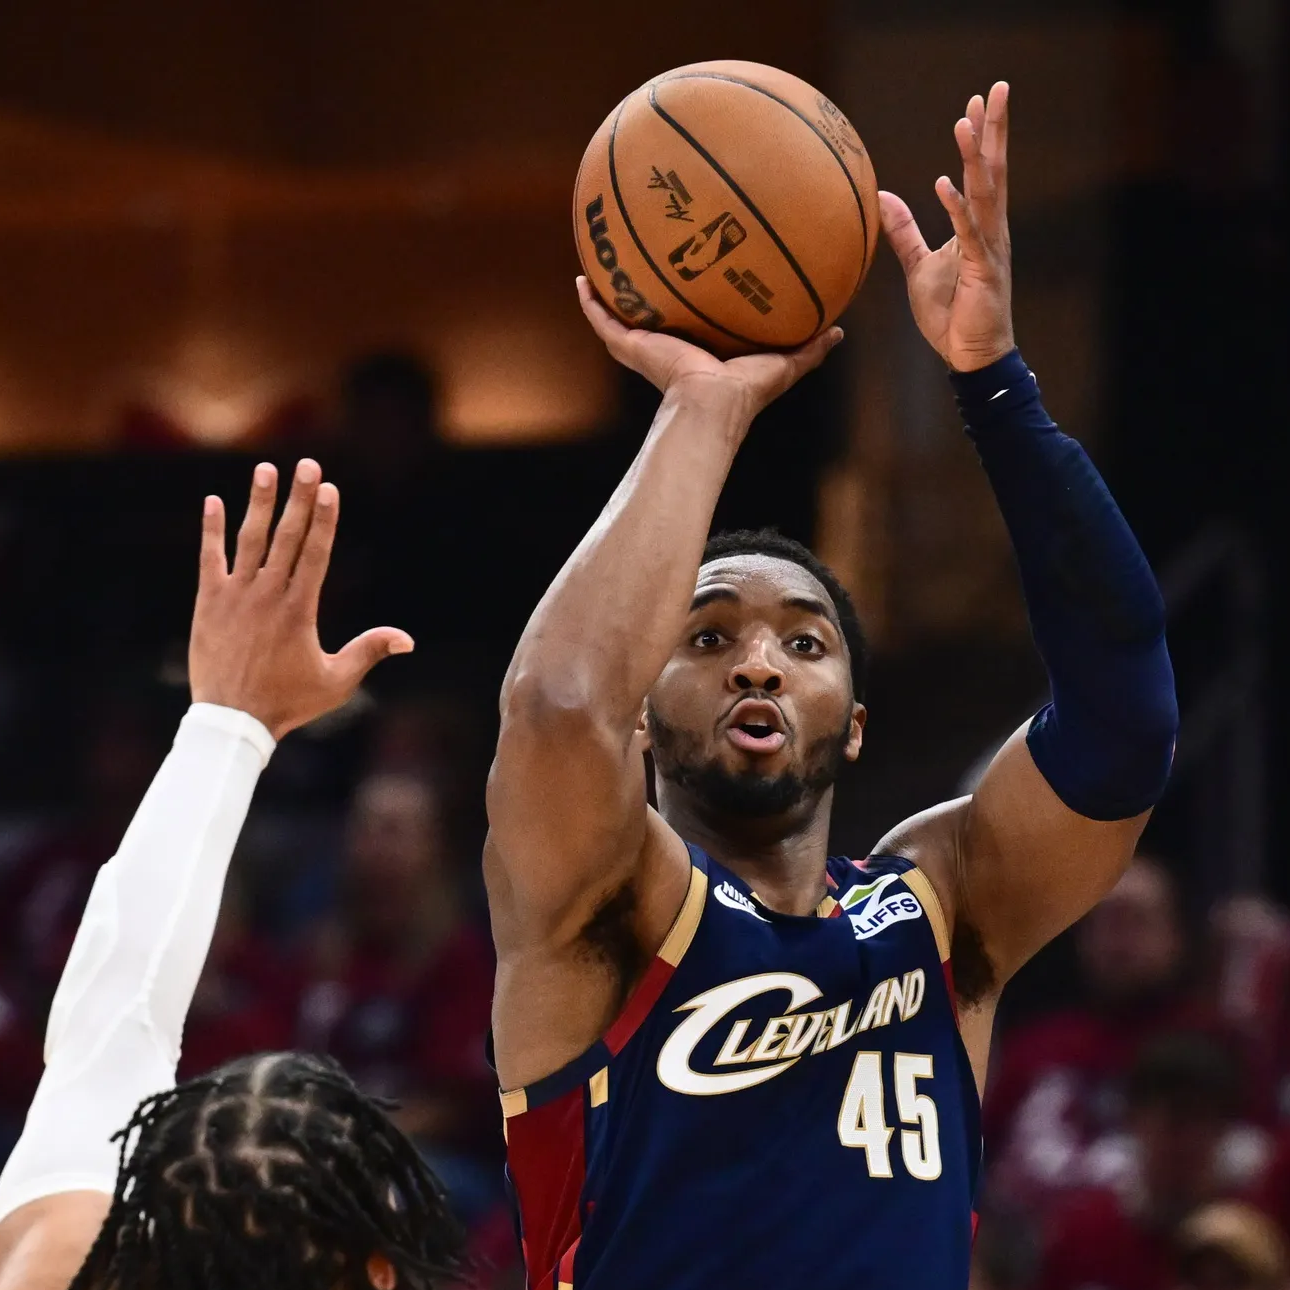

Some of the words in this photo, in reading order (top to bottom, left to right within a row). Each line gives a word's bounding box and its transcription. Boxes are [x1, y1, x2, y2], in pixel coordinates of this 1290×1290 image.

[722, 880, 757, 912] NIKE
[854, 897, 919, 937] LIFFS
[656, 967, 927, 1097] CLEVELAND
[837, 1050, 943, 1181] 45
